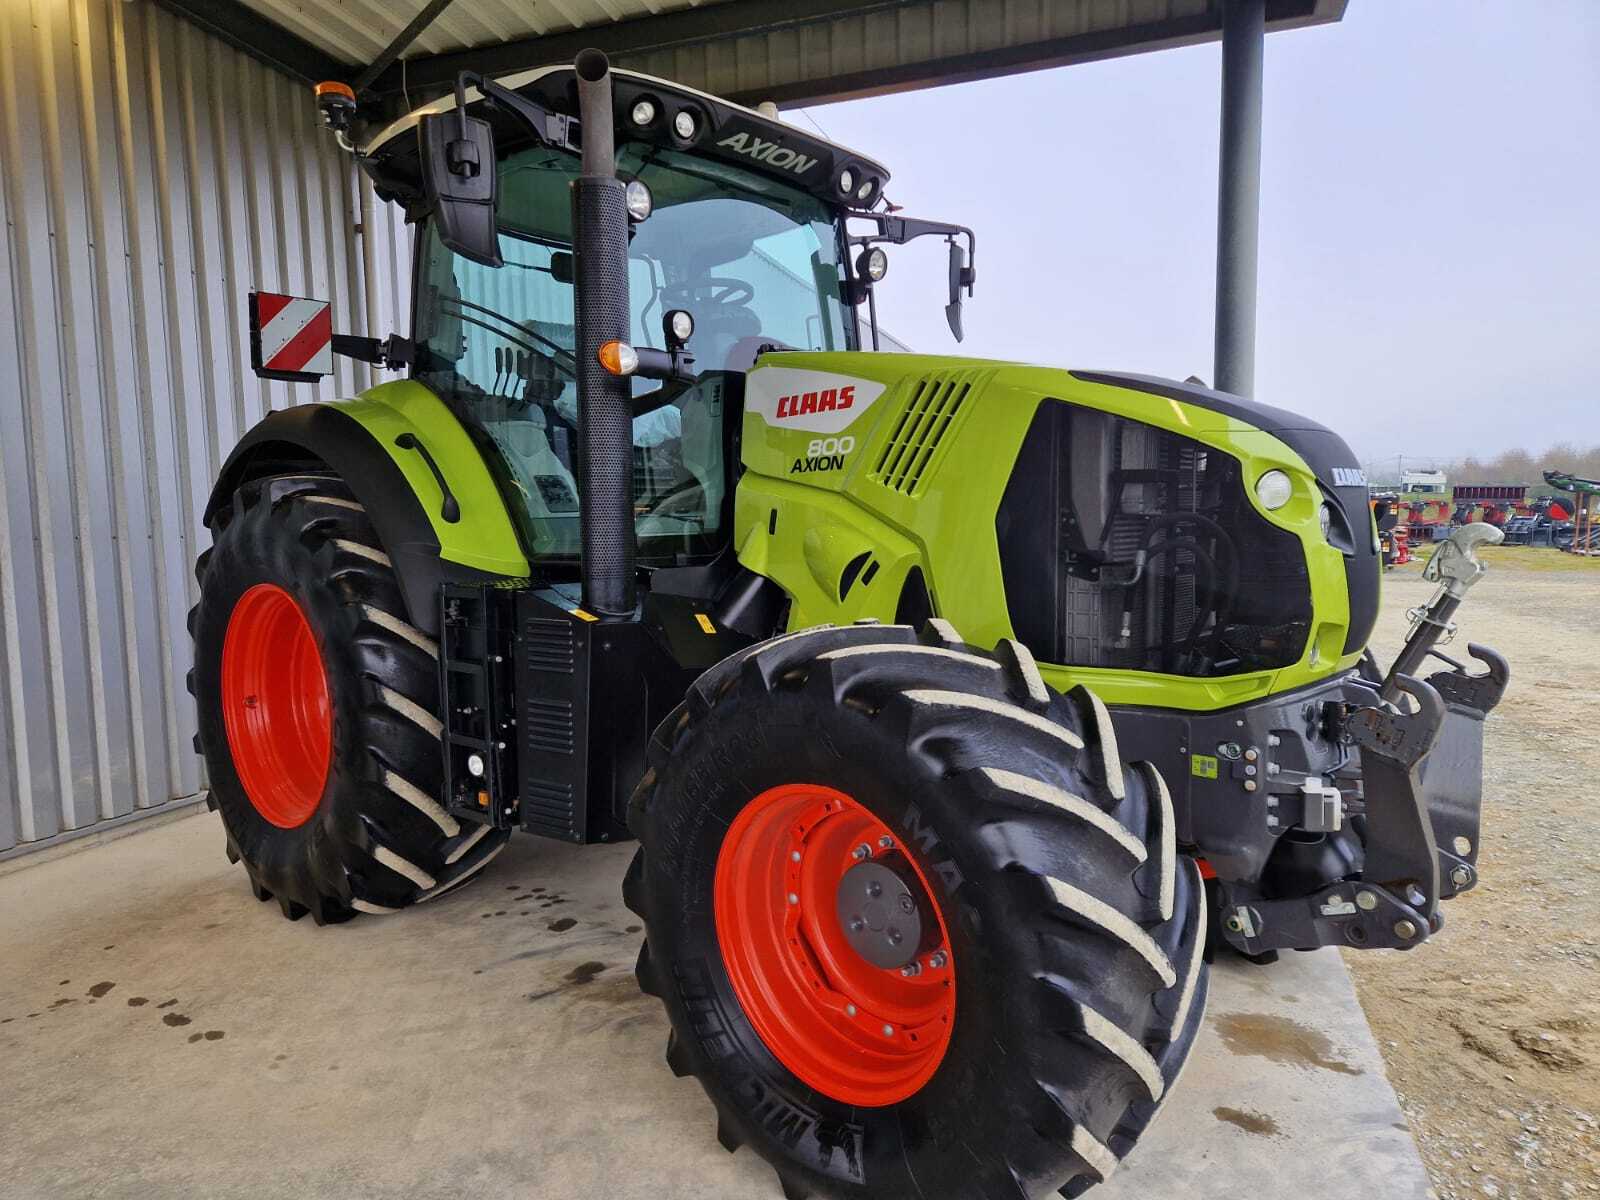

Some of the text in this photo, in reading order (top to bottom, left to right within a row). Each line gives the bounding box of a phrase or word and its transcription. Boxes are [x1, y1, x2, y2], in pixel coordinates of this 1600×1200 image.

[717, 131, 817, 174] AXION
[777, 386, 855, 418] CLAAS
[808, 437, 855, 456] 800
[791, 456, 845, 473] AXION
